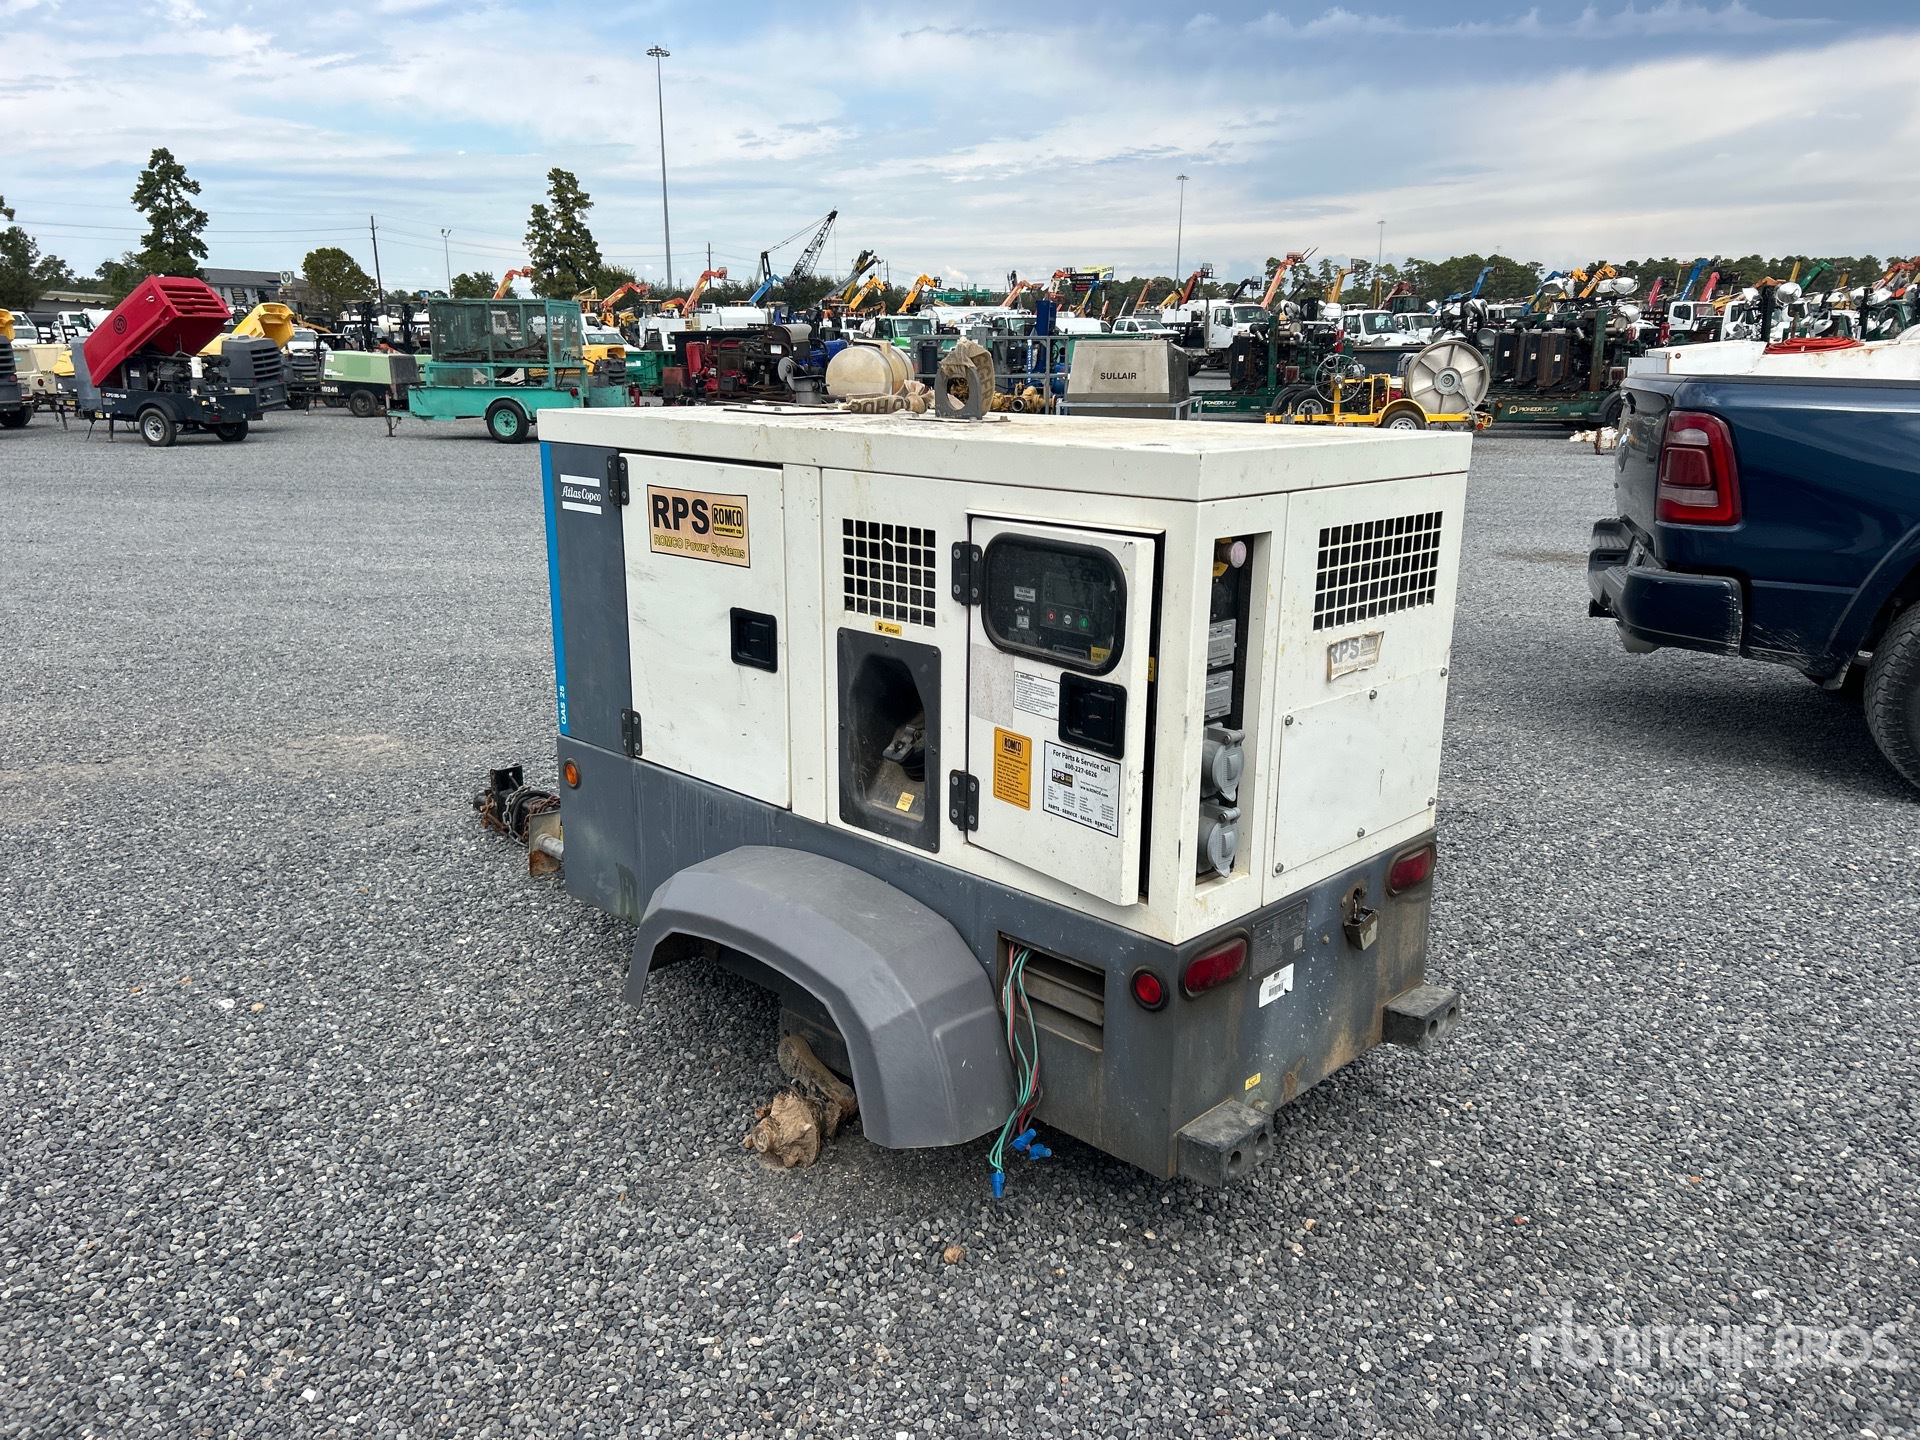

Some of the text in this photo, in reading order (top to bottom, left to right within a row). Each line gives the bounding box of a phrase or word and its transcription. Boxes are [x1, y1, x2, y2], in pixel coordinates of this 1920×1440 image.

[1100, 372, 1137, 380] SULLAIR
[561, 485, 602, 503] Atlas Copco
[651, 493, 711, 535] RPS
[713, 507, 743, 528] ROMCO
[653, 533, 746, 560] ROMCO Power Systems
[884, 626, 900, 635] diesel
[1330, 637, 1360, 665] RPS
[1004, 736, 1022, 752] ROMCO
[1052, 749, 1061, 757] For
[1061, 751, 1075, 763] Parts
[1081, 757, 1100, 770] Service
[1100, 764, 1111, 773] Call
[1052, 770, 1065, 781] RPS
[1064, 762, 1098, 778] 800-227-6626
[1079, 814, 1092, 823] SALES
